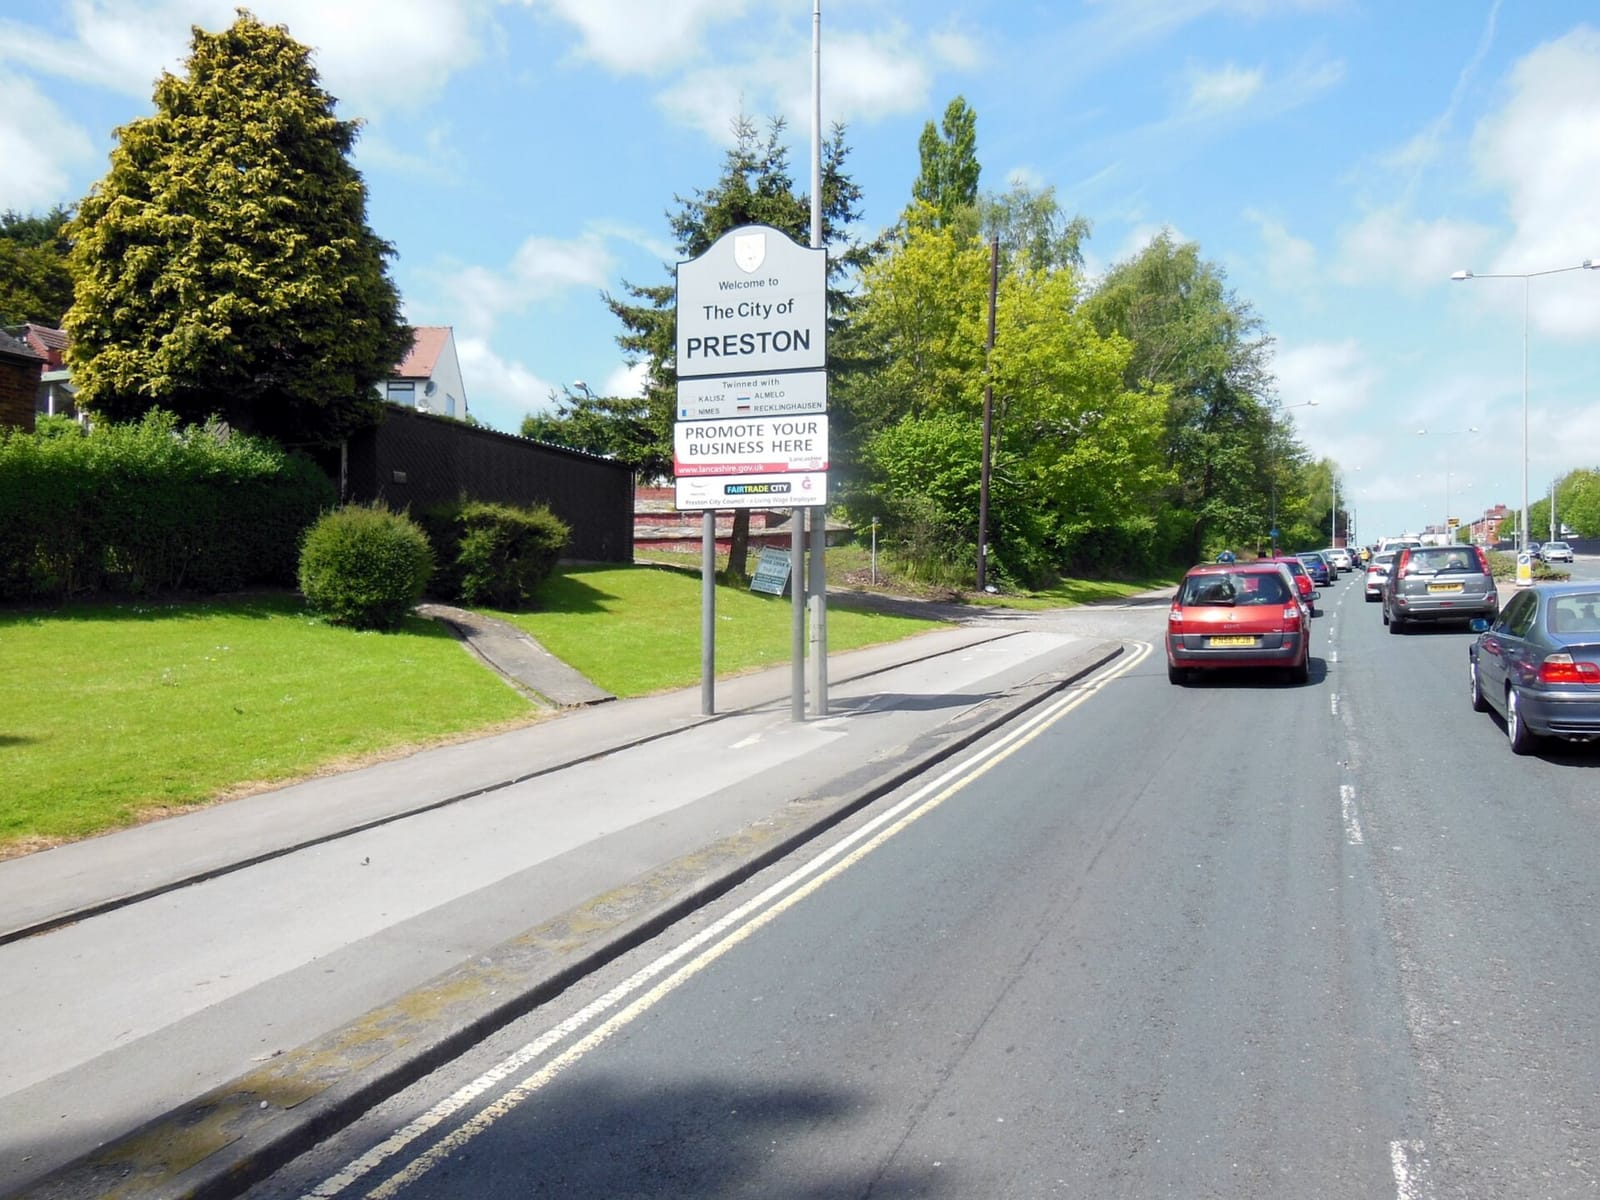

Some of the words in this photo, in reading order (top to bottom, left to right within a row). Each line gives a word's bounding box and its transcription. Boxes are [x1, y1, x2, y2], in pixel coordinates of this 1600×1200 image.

[719, 278, 765, 290] Welcome
[769, 278, 779, 286] to
[703, 305, 734, 320] The
[738, 302, 772, 319] City
[777, 298, 794, 314] of
[687, 329, 810, 359] PRESTON
[723, 381, 757, 389] Twinned
[754, 391, 785, 399] ALMELO
[754, 402, 822, 412] RECKLINGHAUSEN
[686, 424, 764, 439] PROMOTE
[772, 422, 817, 436] YOUR
[690, 441, 764, 456] BUSINESS
[772, 439, 813, 452] HERE
[679, 464, 764, 474] www.lancashire.gov.uk
[727, 485, 769, 493] FAIRTRADE
